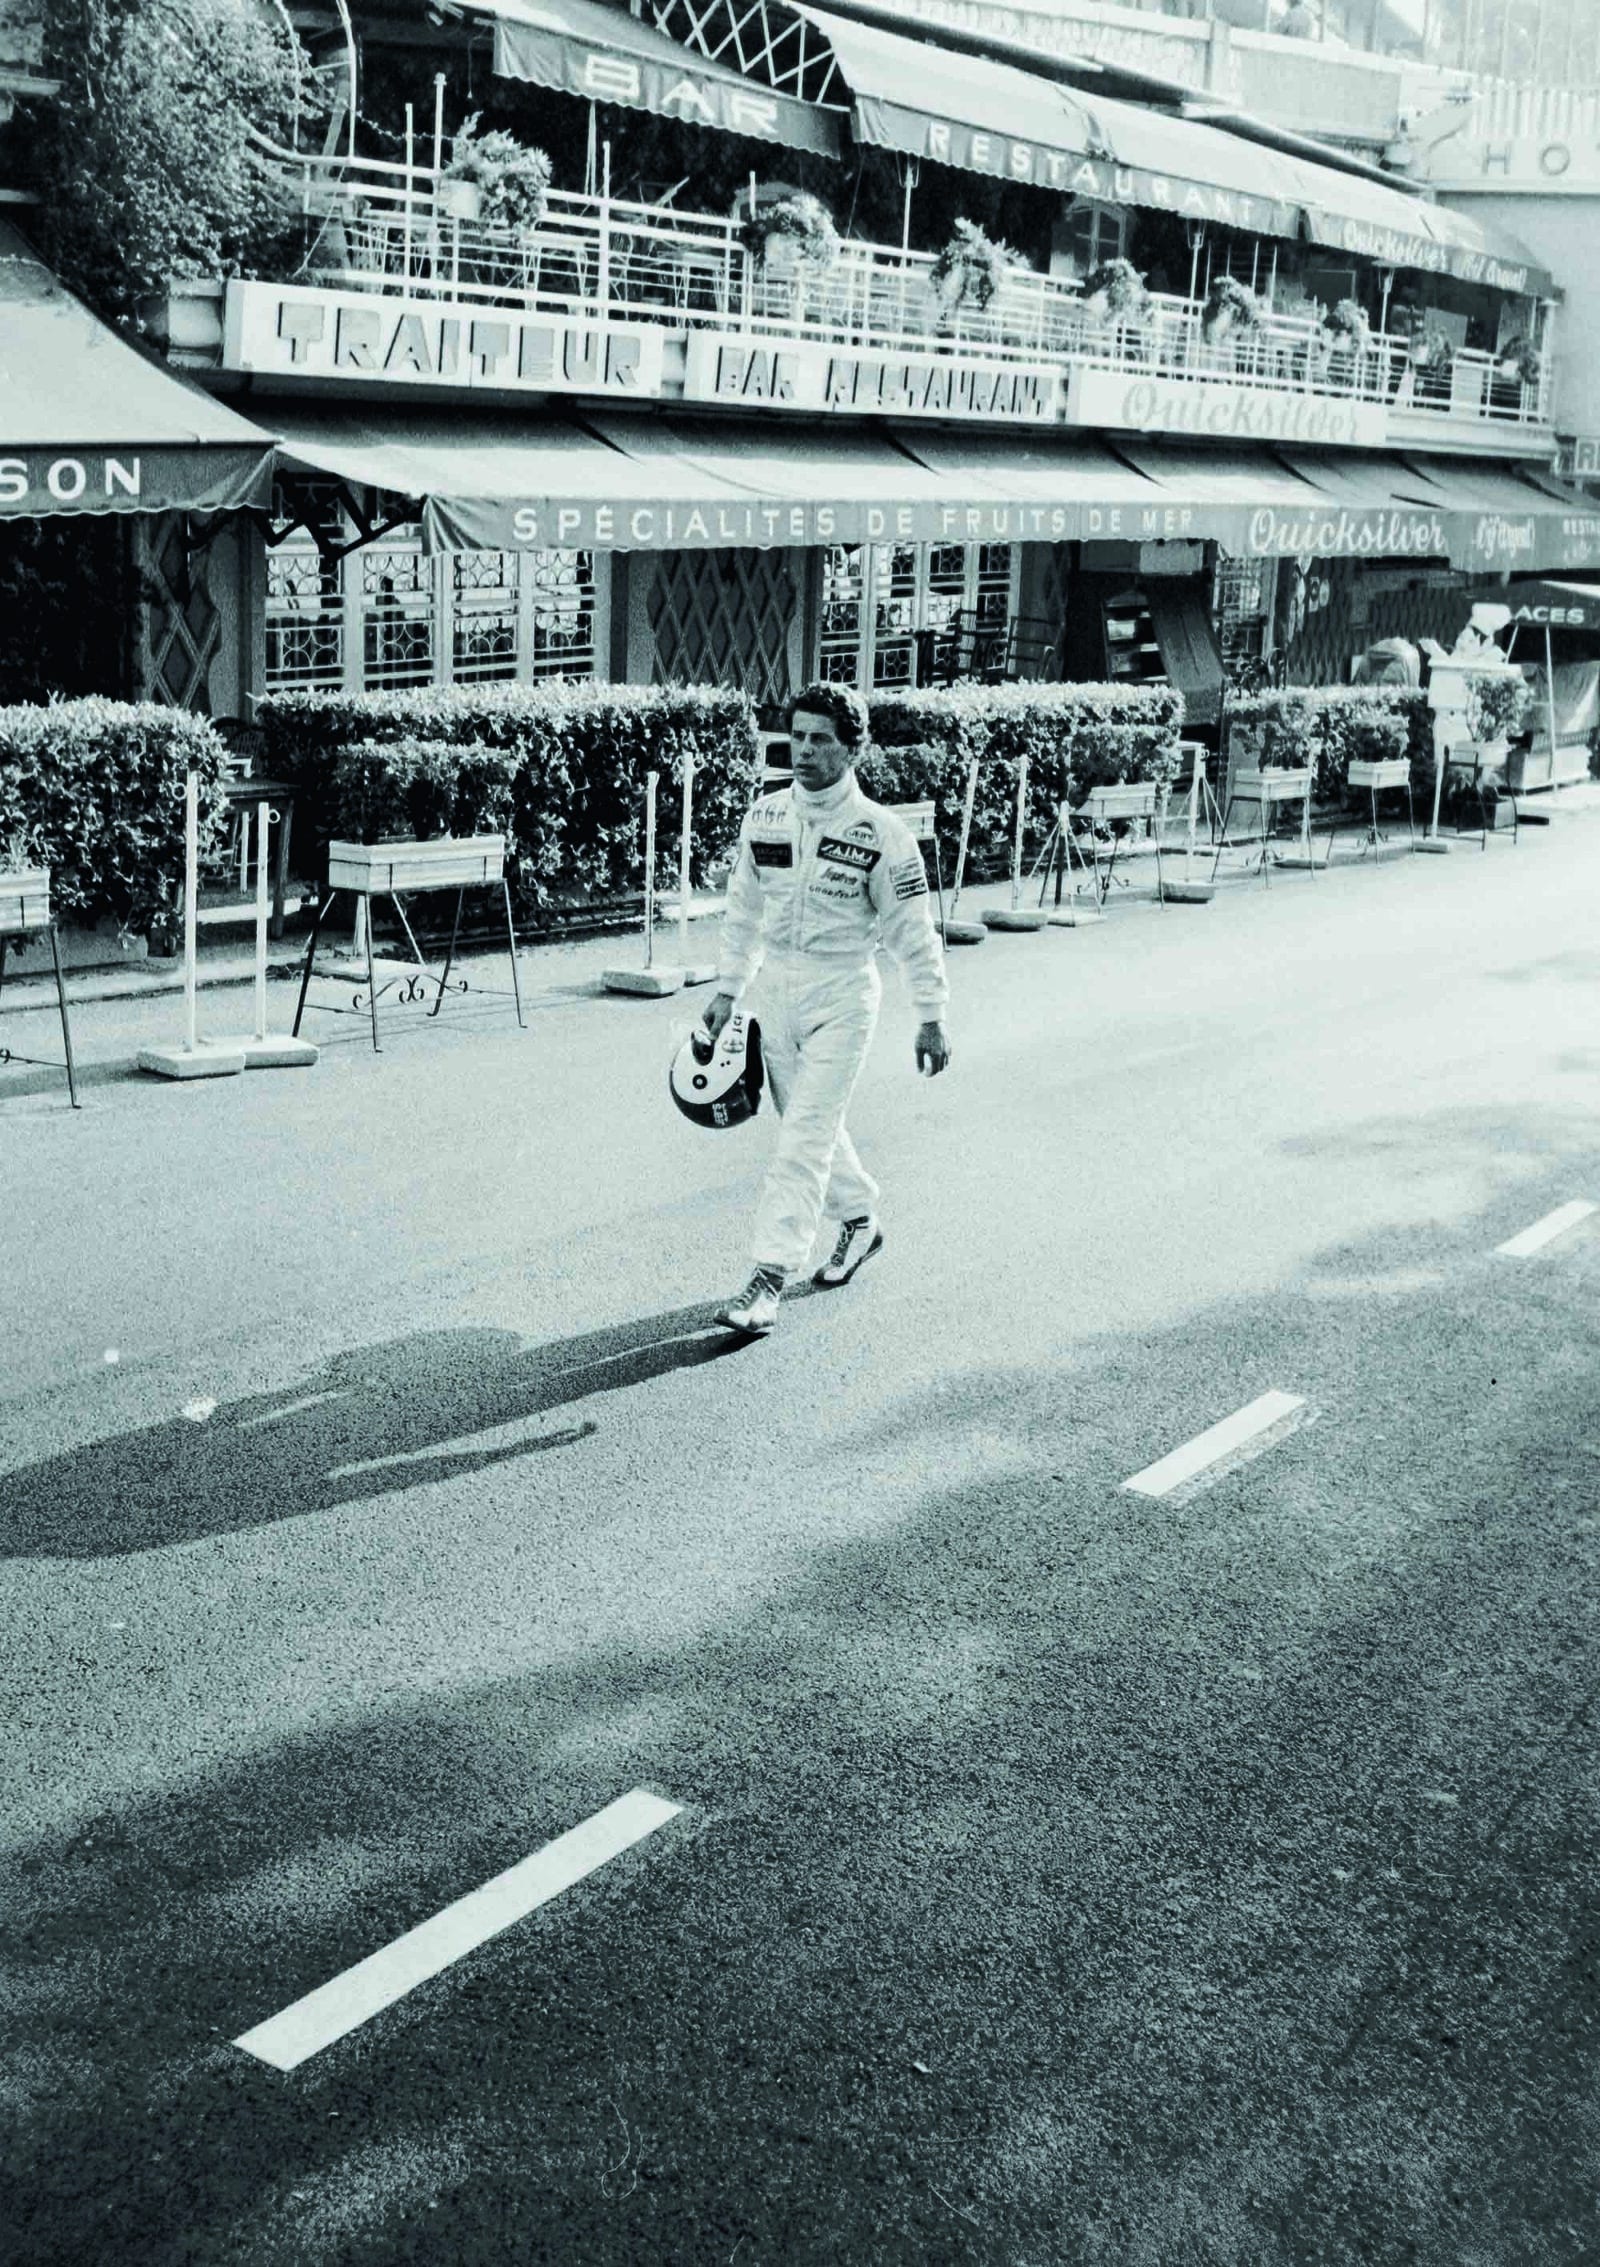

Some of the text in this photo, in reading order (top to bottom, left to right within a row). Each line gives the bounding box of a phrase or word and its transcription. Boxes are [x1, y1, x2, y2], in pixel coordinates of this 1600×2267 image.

[586, 53, 779, 135] BAR
[927, 121, 1253, 221] RESTAURANT
[1480, 142, 1600, 177] HO
[277, 301, 641, 386] TRAITEUR
[715, 345, 1054, 416] BAR RESTAURANT
[1121, 383, 1358, 442] Quicksilver
[0, 458, 141, 500] SON
[867, 508, 913, 537] DE
[942, 508, 1066, 534] FRUITS
[1088, 508, 1121, 533] DE
[1142, 508, 1193, 532] MER
[1250, 508, 1446, 552] Quicksilver
